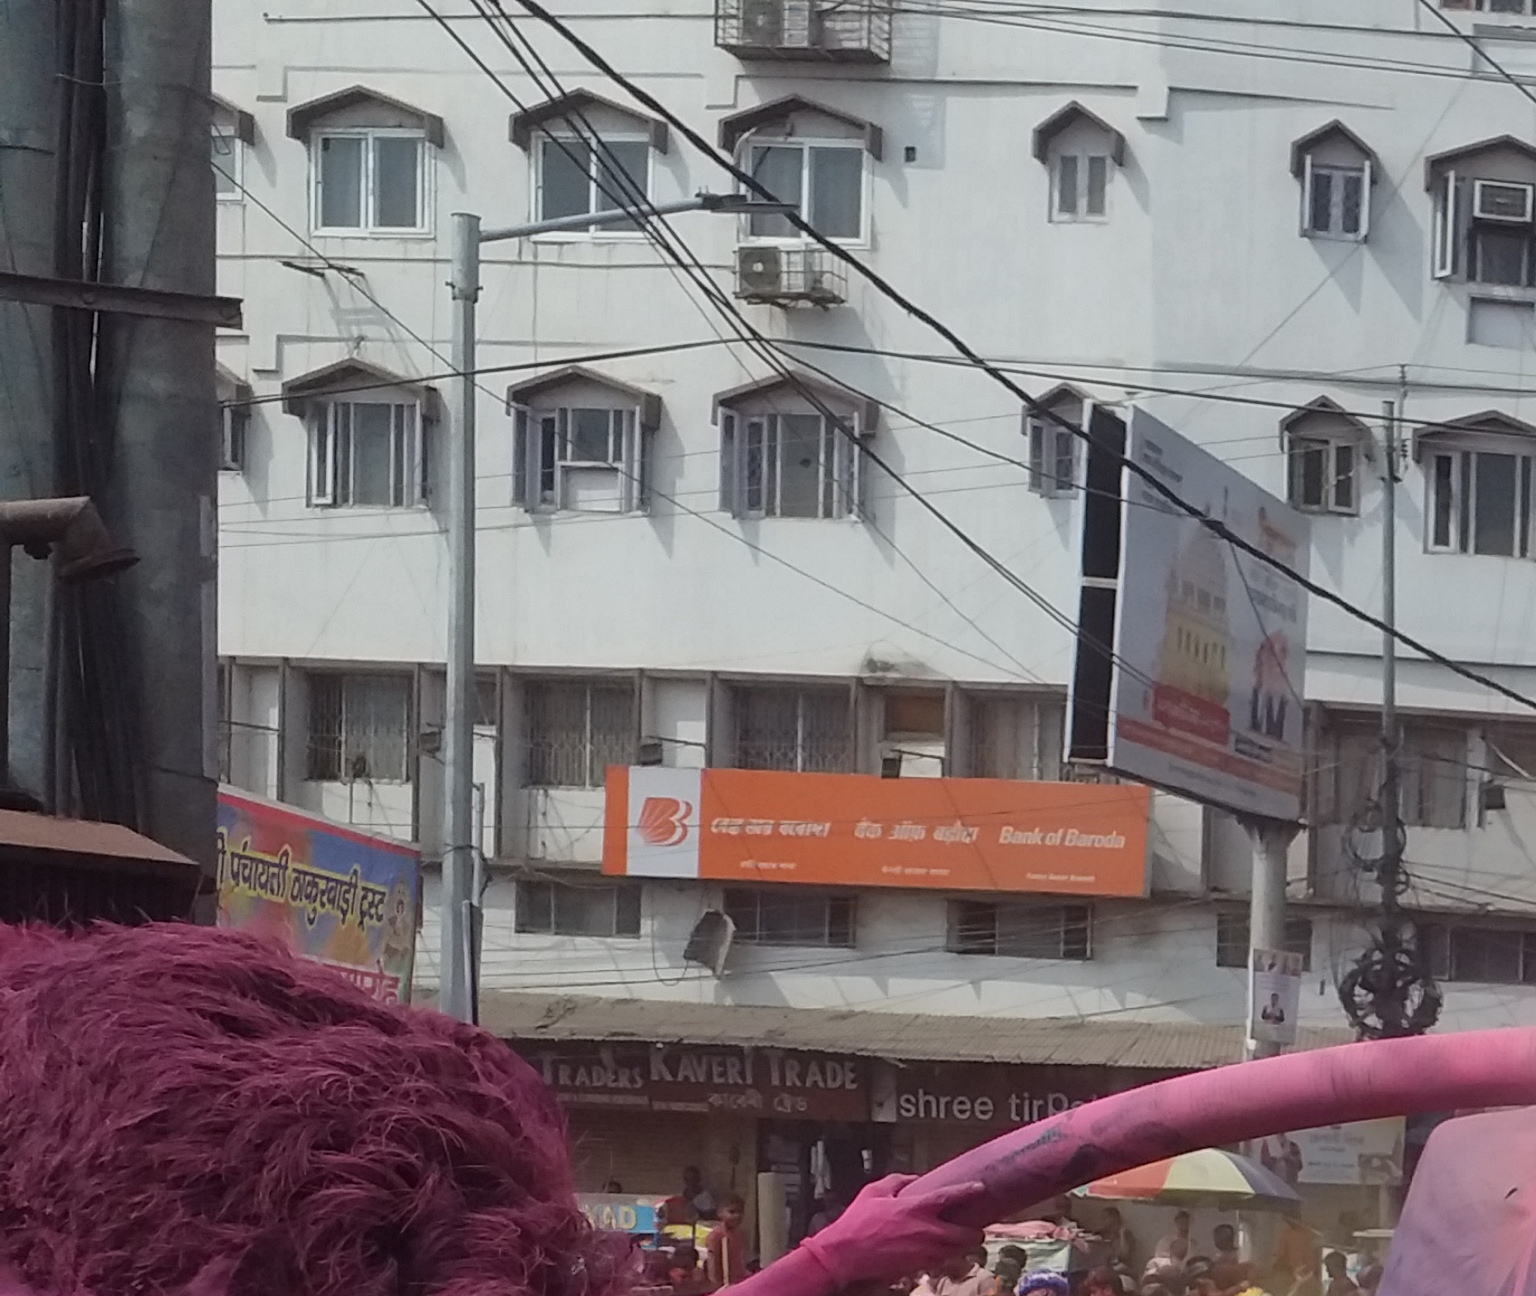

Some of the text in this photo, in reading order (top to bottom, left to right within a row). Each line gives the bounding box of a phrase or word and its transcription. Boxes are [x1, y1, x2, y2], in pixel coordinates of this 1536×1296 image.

[999, 825, 1125, 848] Bank of Baroda
[230, 840, 290, 898] पंचायती
[358, 886, 387, 931] ट्रस्ट
[541, 1051, 645, 1088] TRADERS
[649, 1047, 859, 1090] KAVERI TRADE
[900, 1088, 994, 1120] shree
